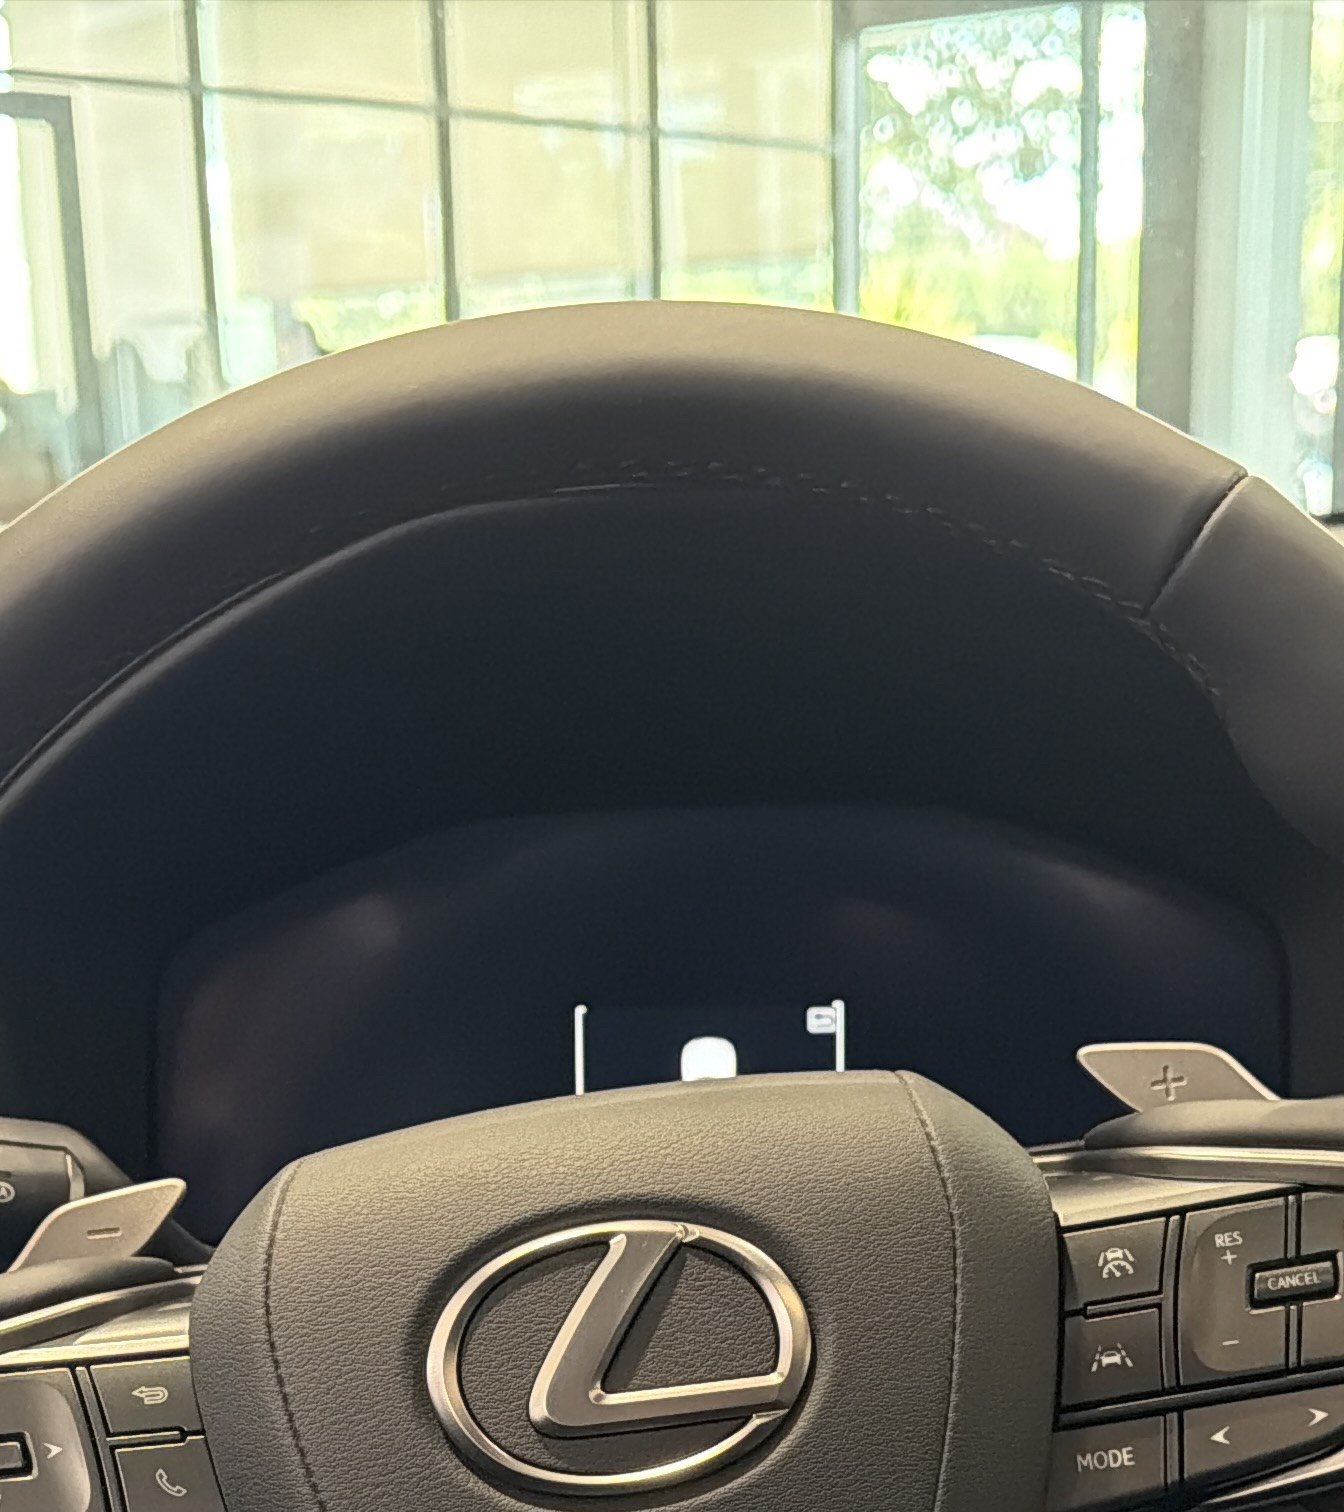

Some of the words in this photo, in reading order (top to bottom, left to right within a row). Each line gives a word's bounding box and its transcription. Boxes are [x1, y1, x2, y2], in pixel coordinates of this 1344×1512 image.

[1214, 1231, 1243, 1248] RES
[1267, 1272, 1321, 1291] CANCEL
[1077, 1447, 1135, 1471] MODE
